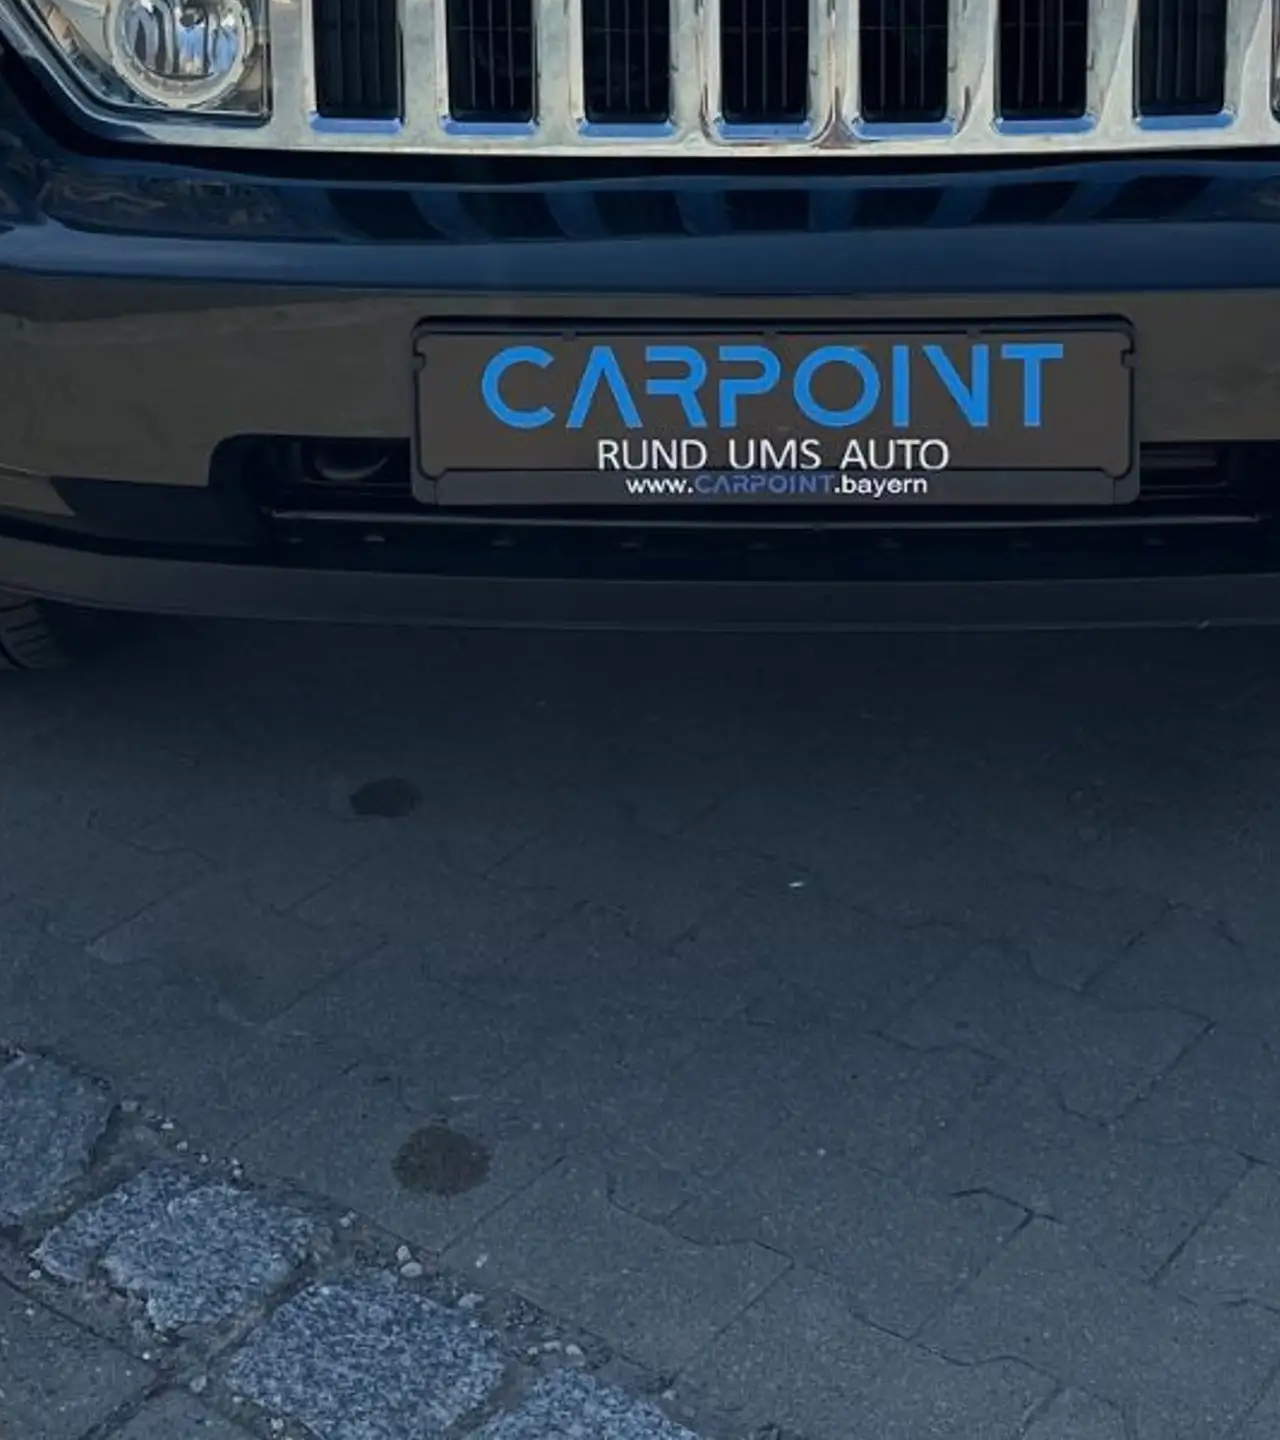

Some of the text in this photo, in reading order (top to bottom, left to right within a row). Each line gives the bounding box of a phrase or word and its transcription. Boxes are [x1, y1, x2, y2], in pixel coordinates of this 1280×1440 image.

[481, 343, 1064, 429] CARPOINT
[597, 438, 950, 470] RUND UMS AUTO
[625, 474, 929, 497] www.CARPOINT.bayern
